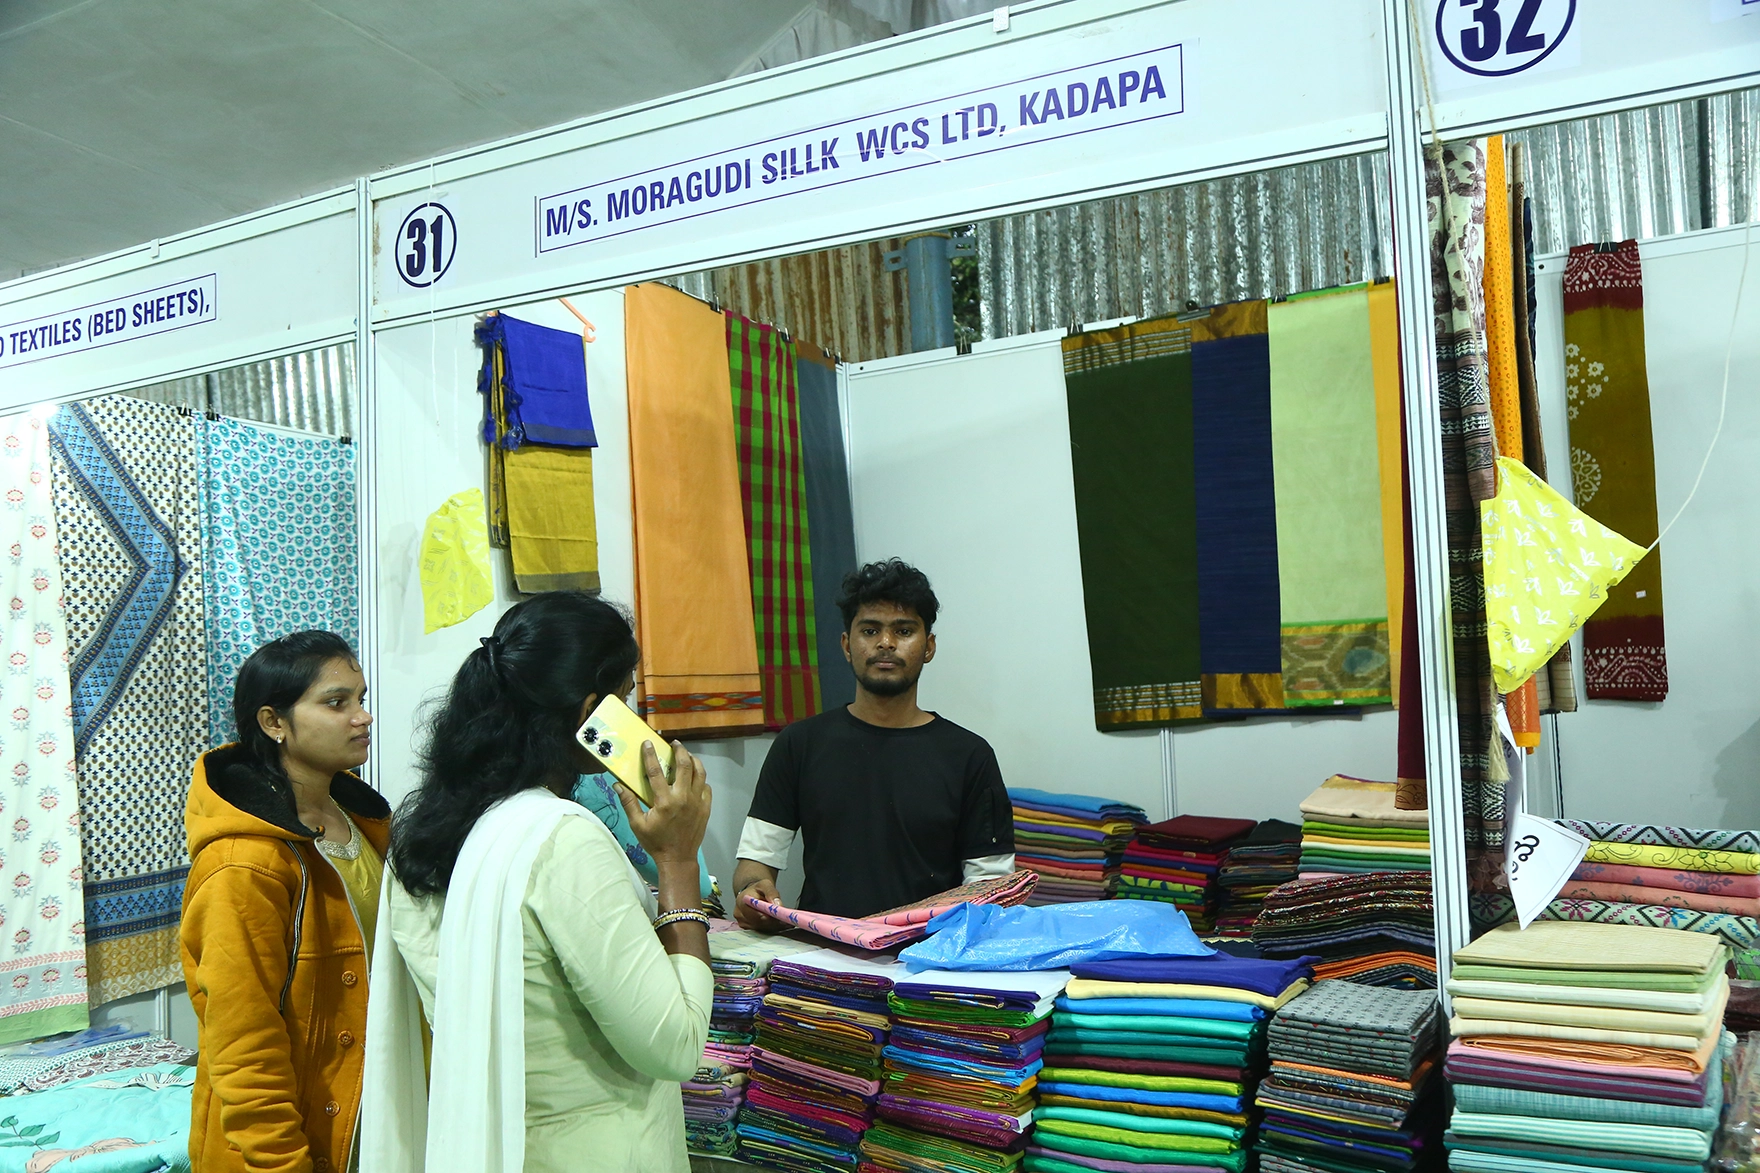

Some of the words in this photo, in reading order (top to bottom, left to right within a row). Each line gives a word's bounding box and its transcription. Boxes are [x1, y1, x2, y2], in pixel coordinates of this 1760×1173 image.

[1460, 0, 1546, 62] 32
[547, 198, 598, 237] M/S.
[608, 158, 751, 222] MORAGUDI
[762, 138, 840, 185] SILLK
[856, 121, 930, 163] WCS
[941, 103, 1007, 145] LTD,
[1020, 64, 1167, 127] KADAPA
[406, 215, 443, 278] 31
[9, 317, 82, 355] TEXTILES
[87, 307, 127, 343] (BED
[132, 286, 210, 328] SHEETS),
